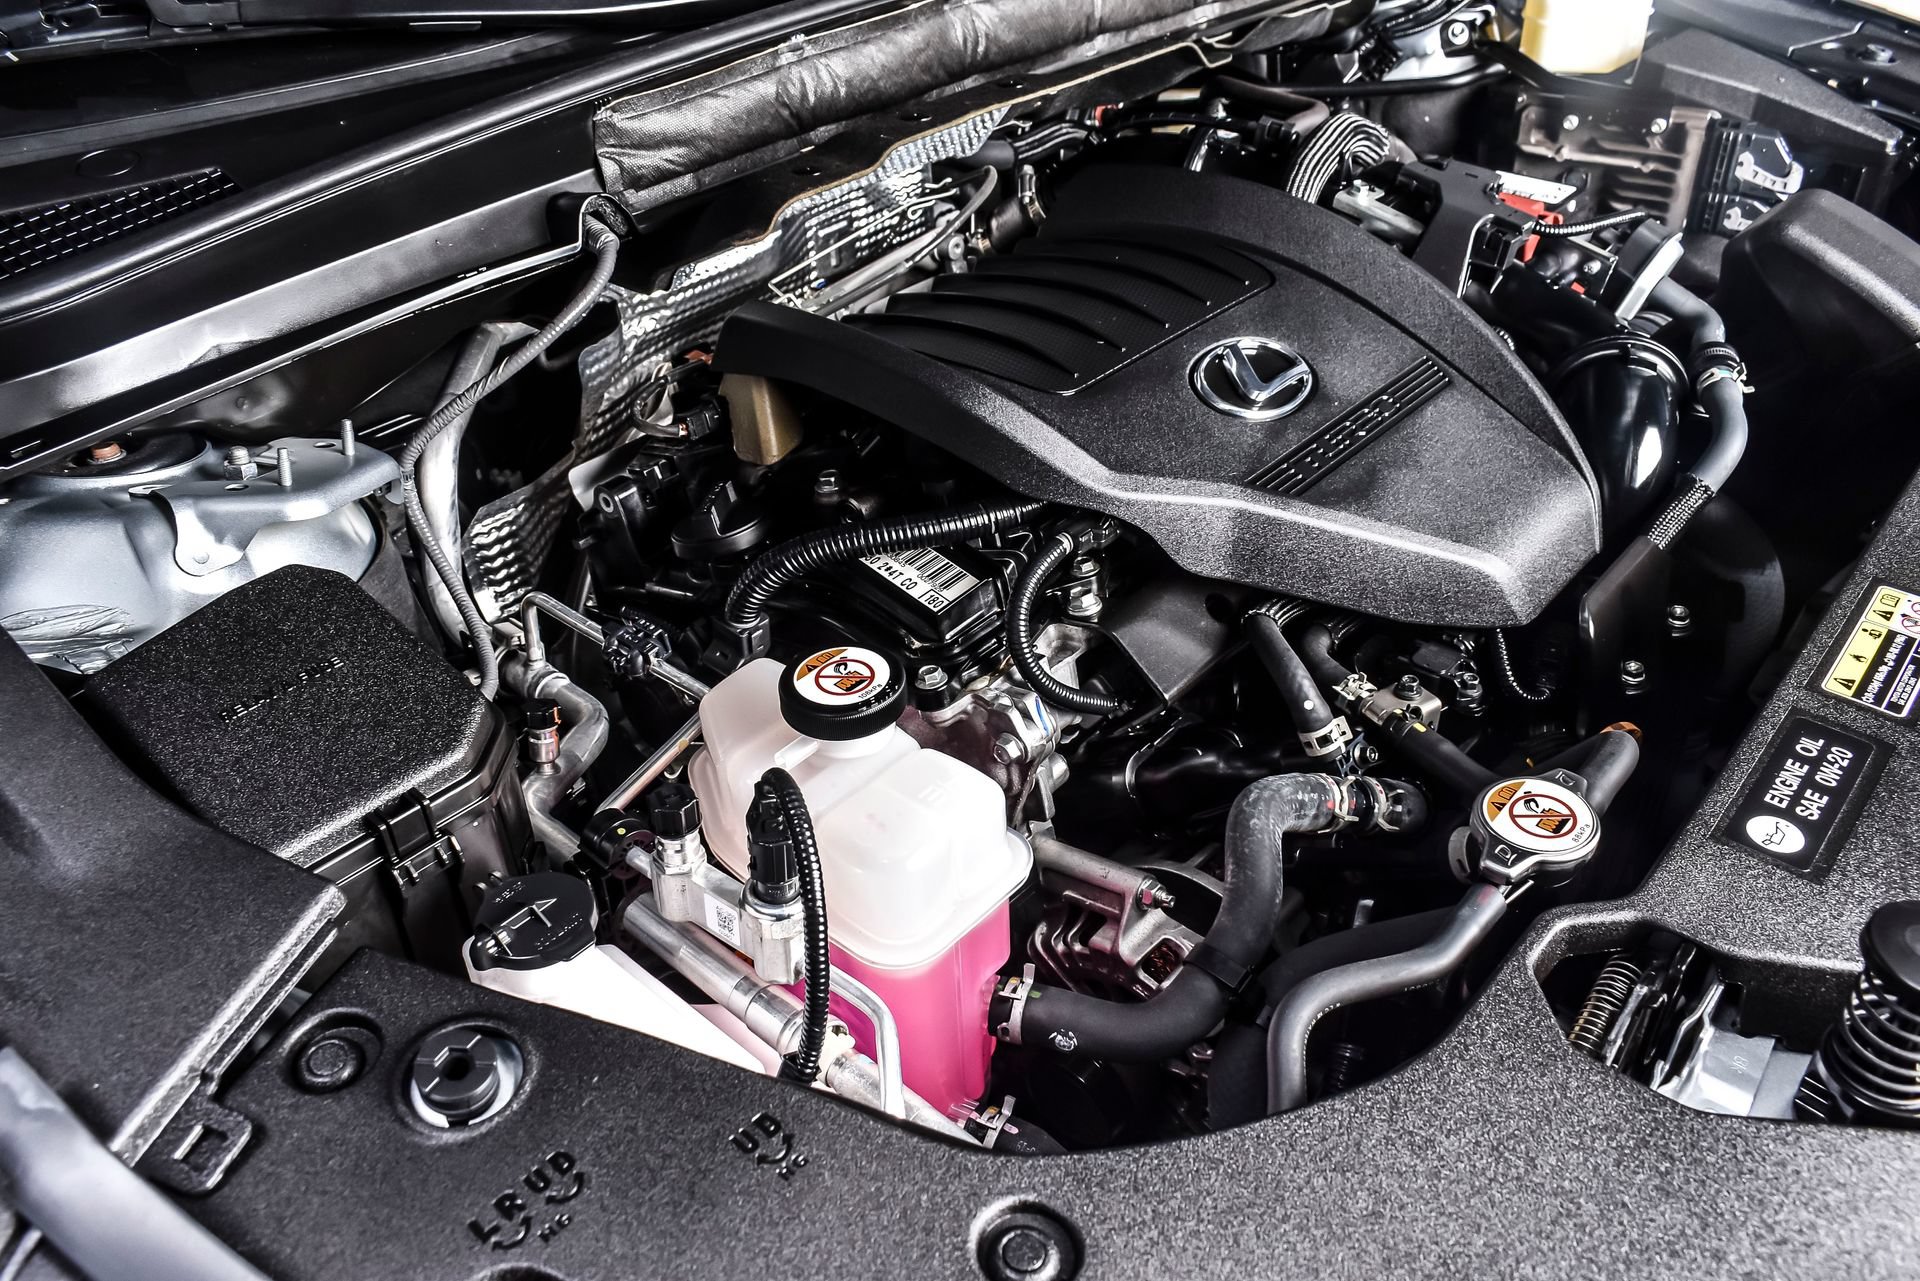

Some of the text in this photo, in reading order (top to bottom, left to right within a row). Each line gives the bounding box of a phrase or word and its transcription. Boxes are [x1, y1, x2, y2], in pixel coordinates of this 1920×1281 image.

[924, 595, 945, 609] 180
[1764, 736, 1825, 809] ENGINE OIL
[1795, 746, 1854, 821] SAE 0W-20
